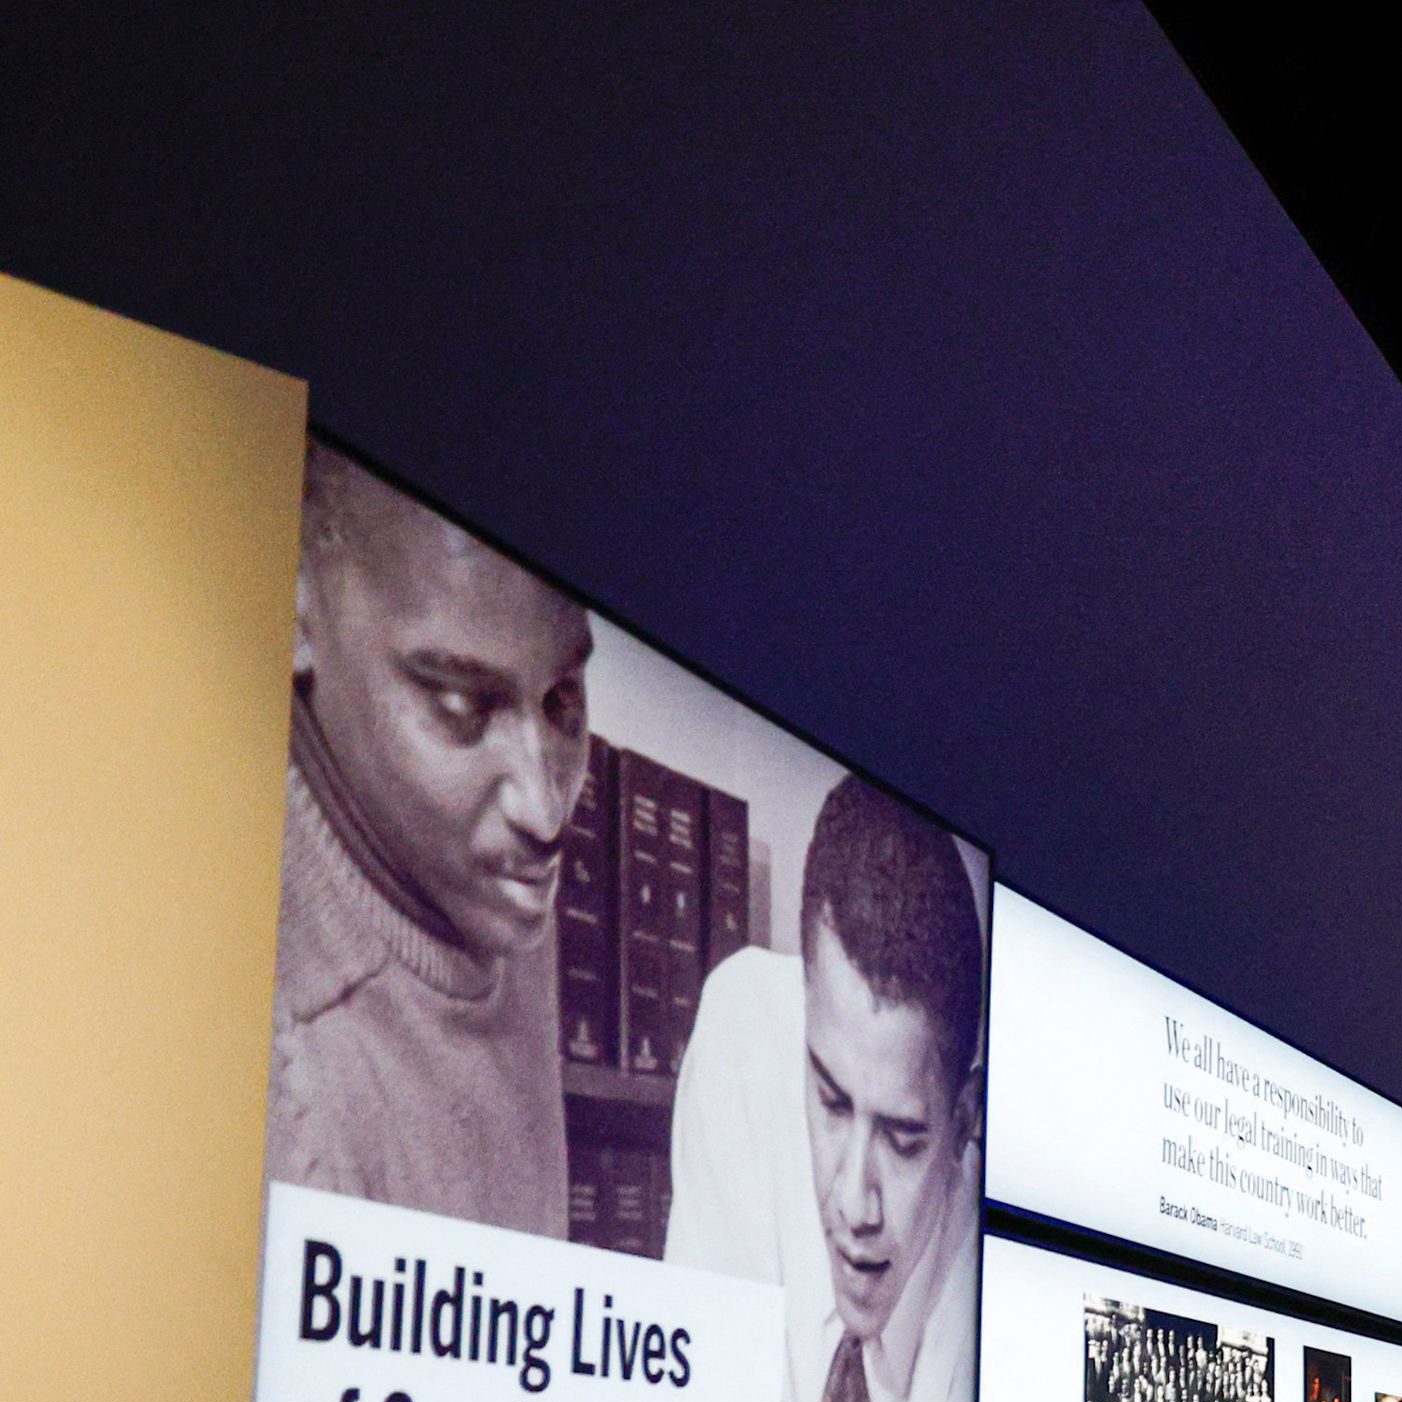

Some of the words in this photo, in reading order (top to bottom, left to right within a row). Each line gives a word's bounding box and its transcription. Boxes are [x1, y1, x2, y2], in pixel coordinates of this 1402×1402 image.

[1164, 1015, 1191, 1064] We
[1194, 1034, 1213, 1074] all
[1216, 1041, 1250, 1092] have
[1252, 1073, 1260, 1098] a
[1264, 1078, 1350, 1148] responsibility
[1352, 1117, 1364, 1147] to
[1162, 1136, 1206, 1177] make
[1209, 1150, 1237, 1189] this
[1239, 1169, 1293, 1218] country
[1296, 1191, 1328, 1225] work
[1330, 1196, 1367, 1240] better.
[1164, 1082, 1191, 1118] use
[1194, 1098, 1222, 1130] our
[1224, 1100, 1257, 1149] legal
[1260, 1120, 1314, 1176] training
[1315, 1143, 1327, 1178] in
[1330, 1158, 1358, 1195] ways
[1360, 1163, 1382, 1202] that
[1159, 1195, 1188, 1222] Barack
[1190, 1206, 1218, 1232] Obama
[300, 1239, 555, 1393] Building
[571, 1288, 692, 1389] Lives
